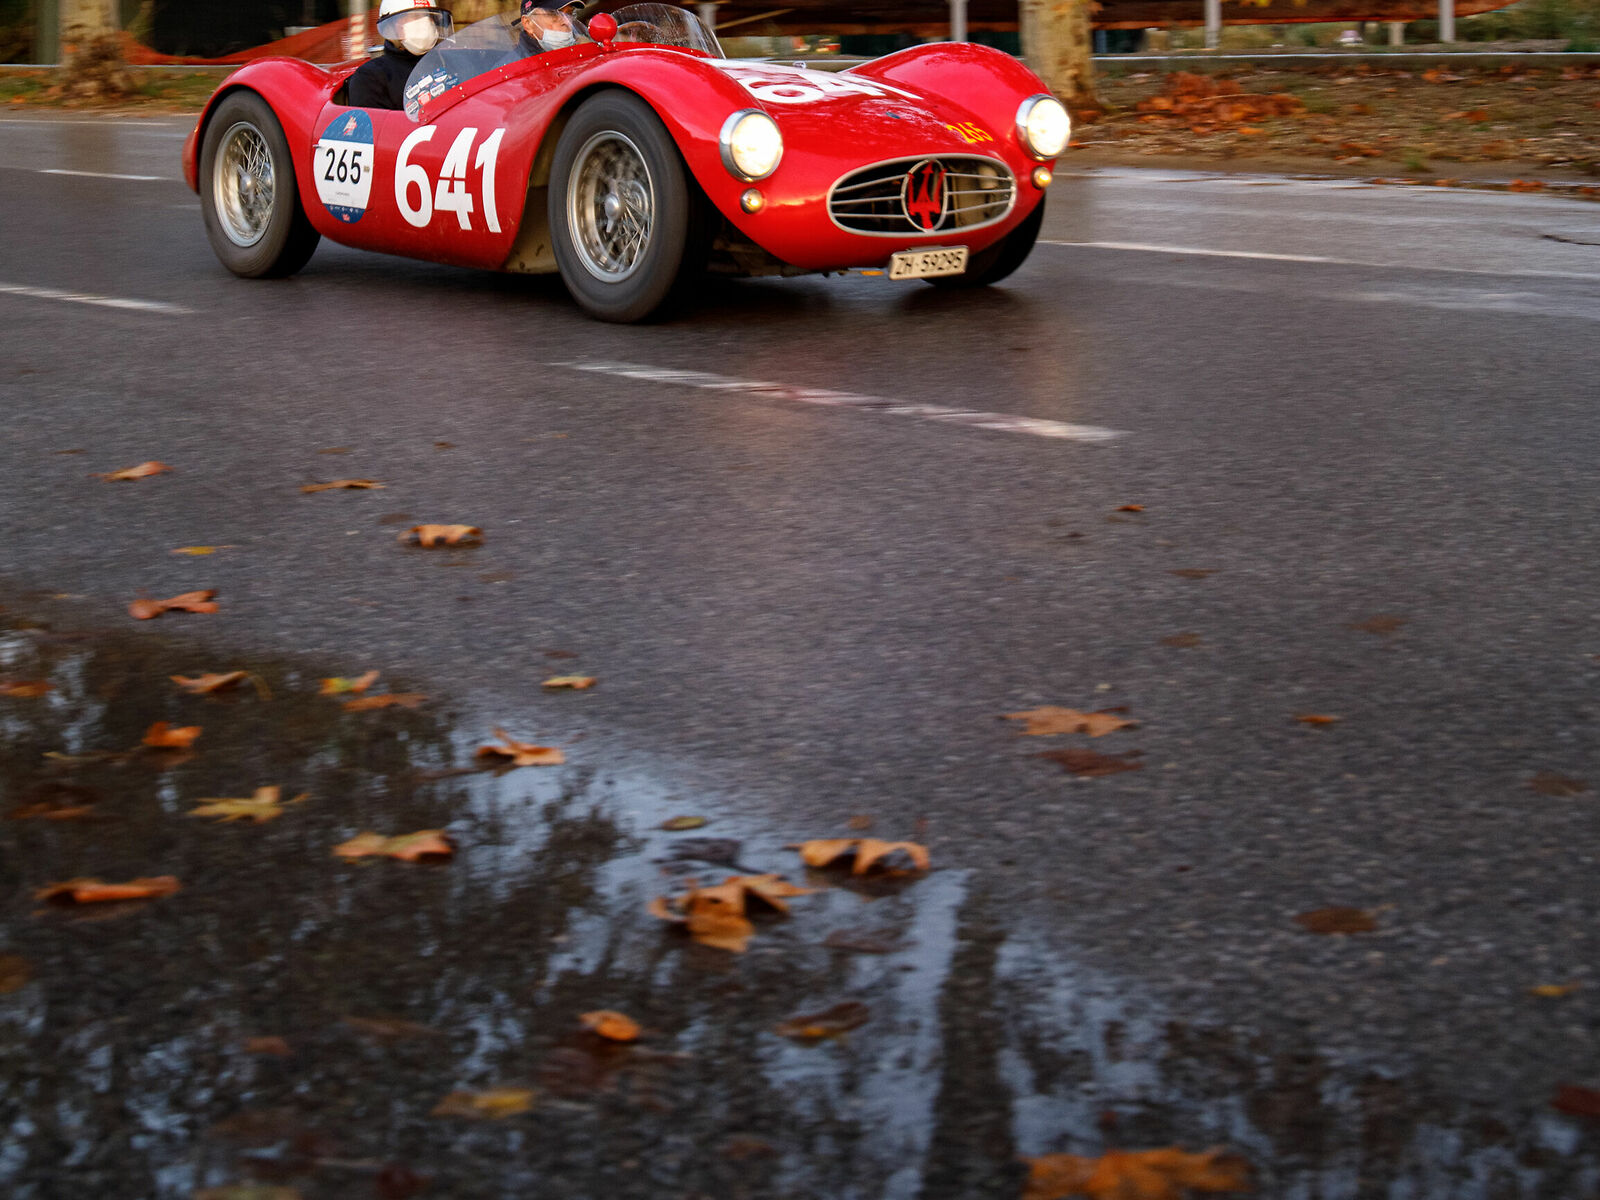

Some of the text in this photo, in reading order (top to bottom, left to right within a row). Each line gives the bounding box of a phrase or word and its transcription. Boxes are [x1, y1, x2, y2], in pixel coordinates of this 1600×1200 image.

[946, 121, 994, 143] 265
[324, 148, 362, 185] 265
[394, 125, 506, 234] 641
